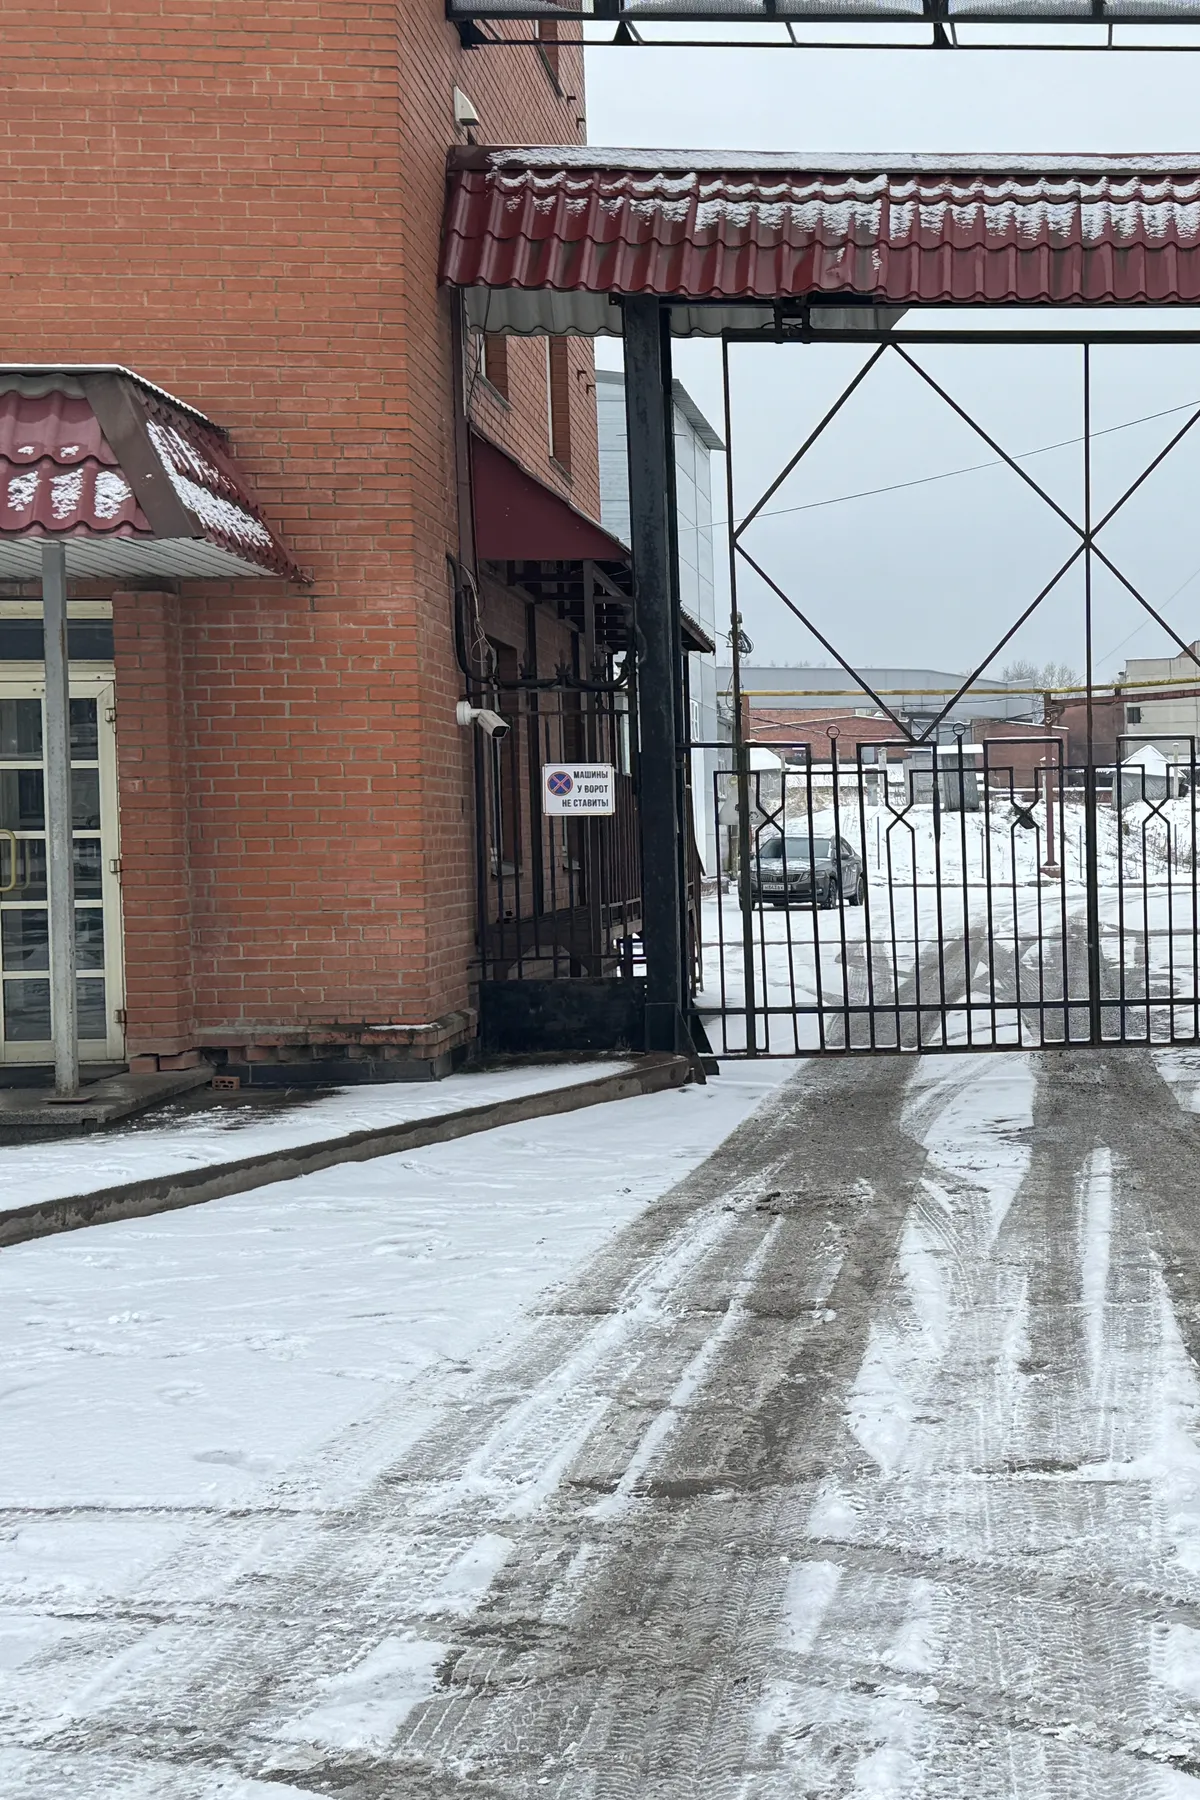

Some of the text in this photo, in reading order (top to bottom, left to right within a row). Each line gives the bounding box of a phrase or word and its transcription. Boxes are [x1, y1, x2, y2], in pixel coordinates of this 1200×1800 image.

[577, 785, 609, 793] У ВОРОТ
[562, 799, 572, 807] НЕ
